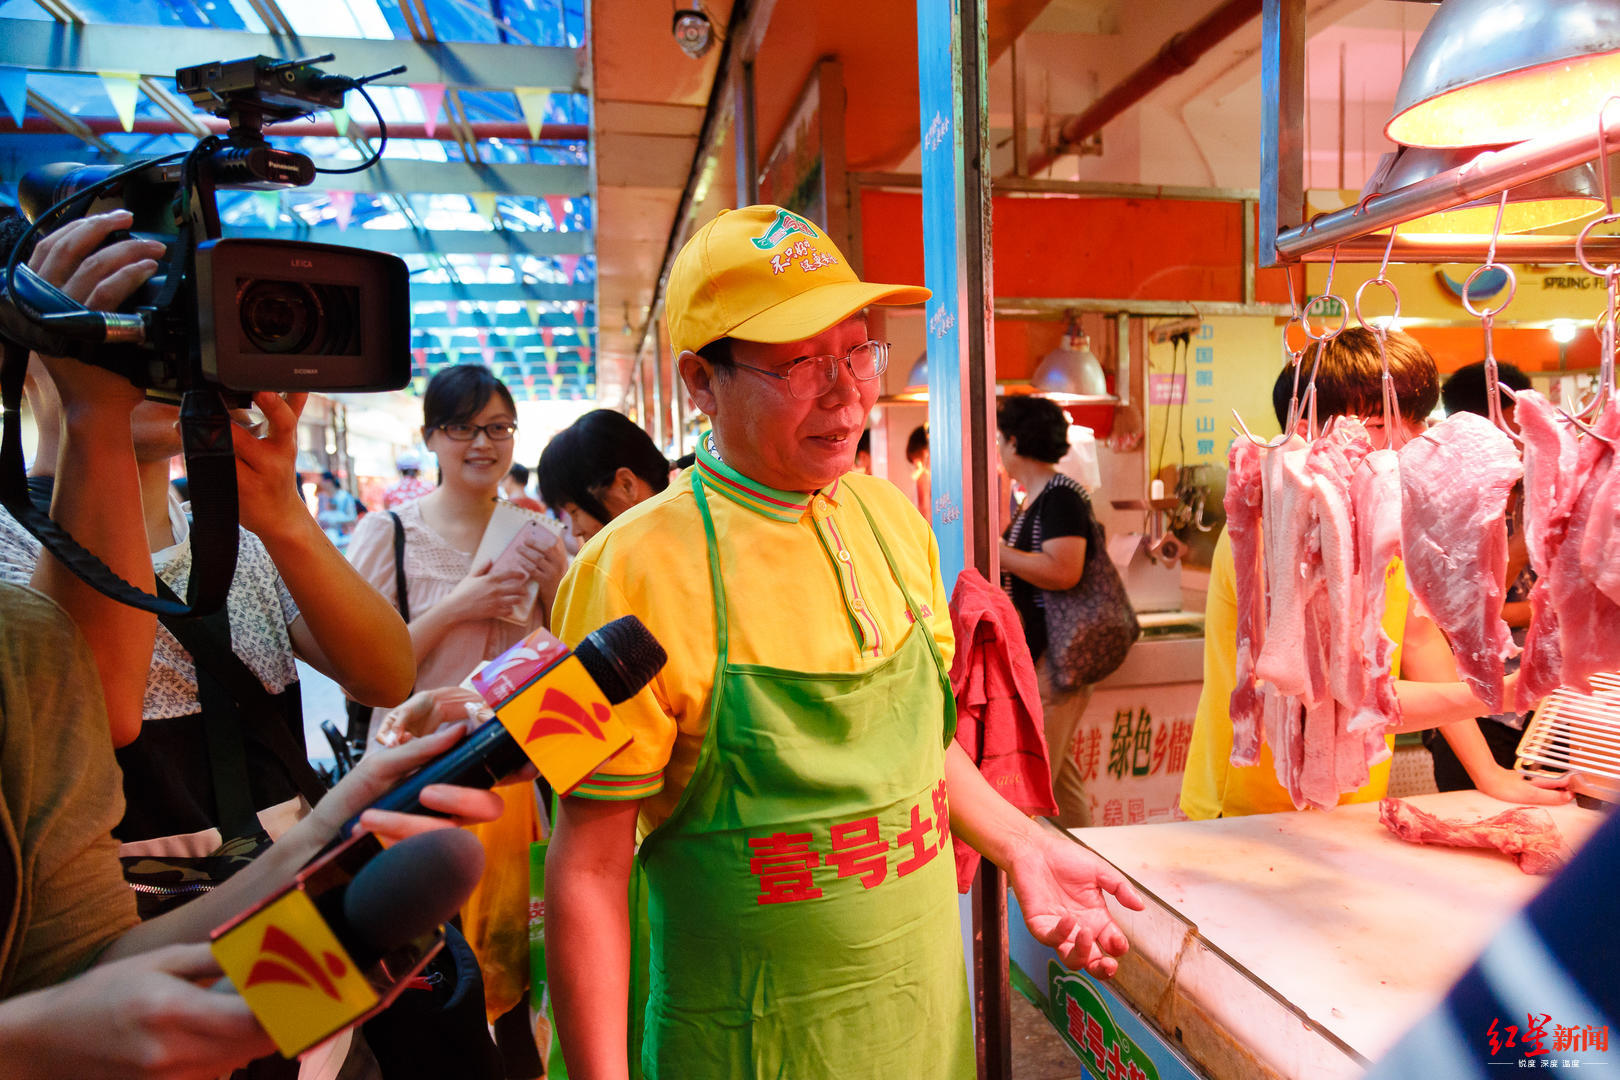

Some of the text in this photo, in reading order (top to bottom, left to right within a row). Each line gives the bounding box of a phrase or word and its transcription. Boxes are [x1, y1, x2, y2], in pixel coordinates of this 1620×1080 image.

[290, 258, 313, 268] LEICA
[1543, 277, 1591, 290] SPRING
[1196, 323, 1215, 465] 中国第一山泉
